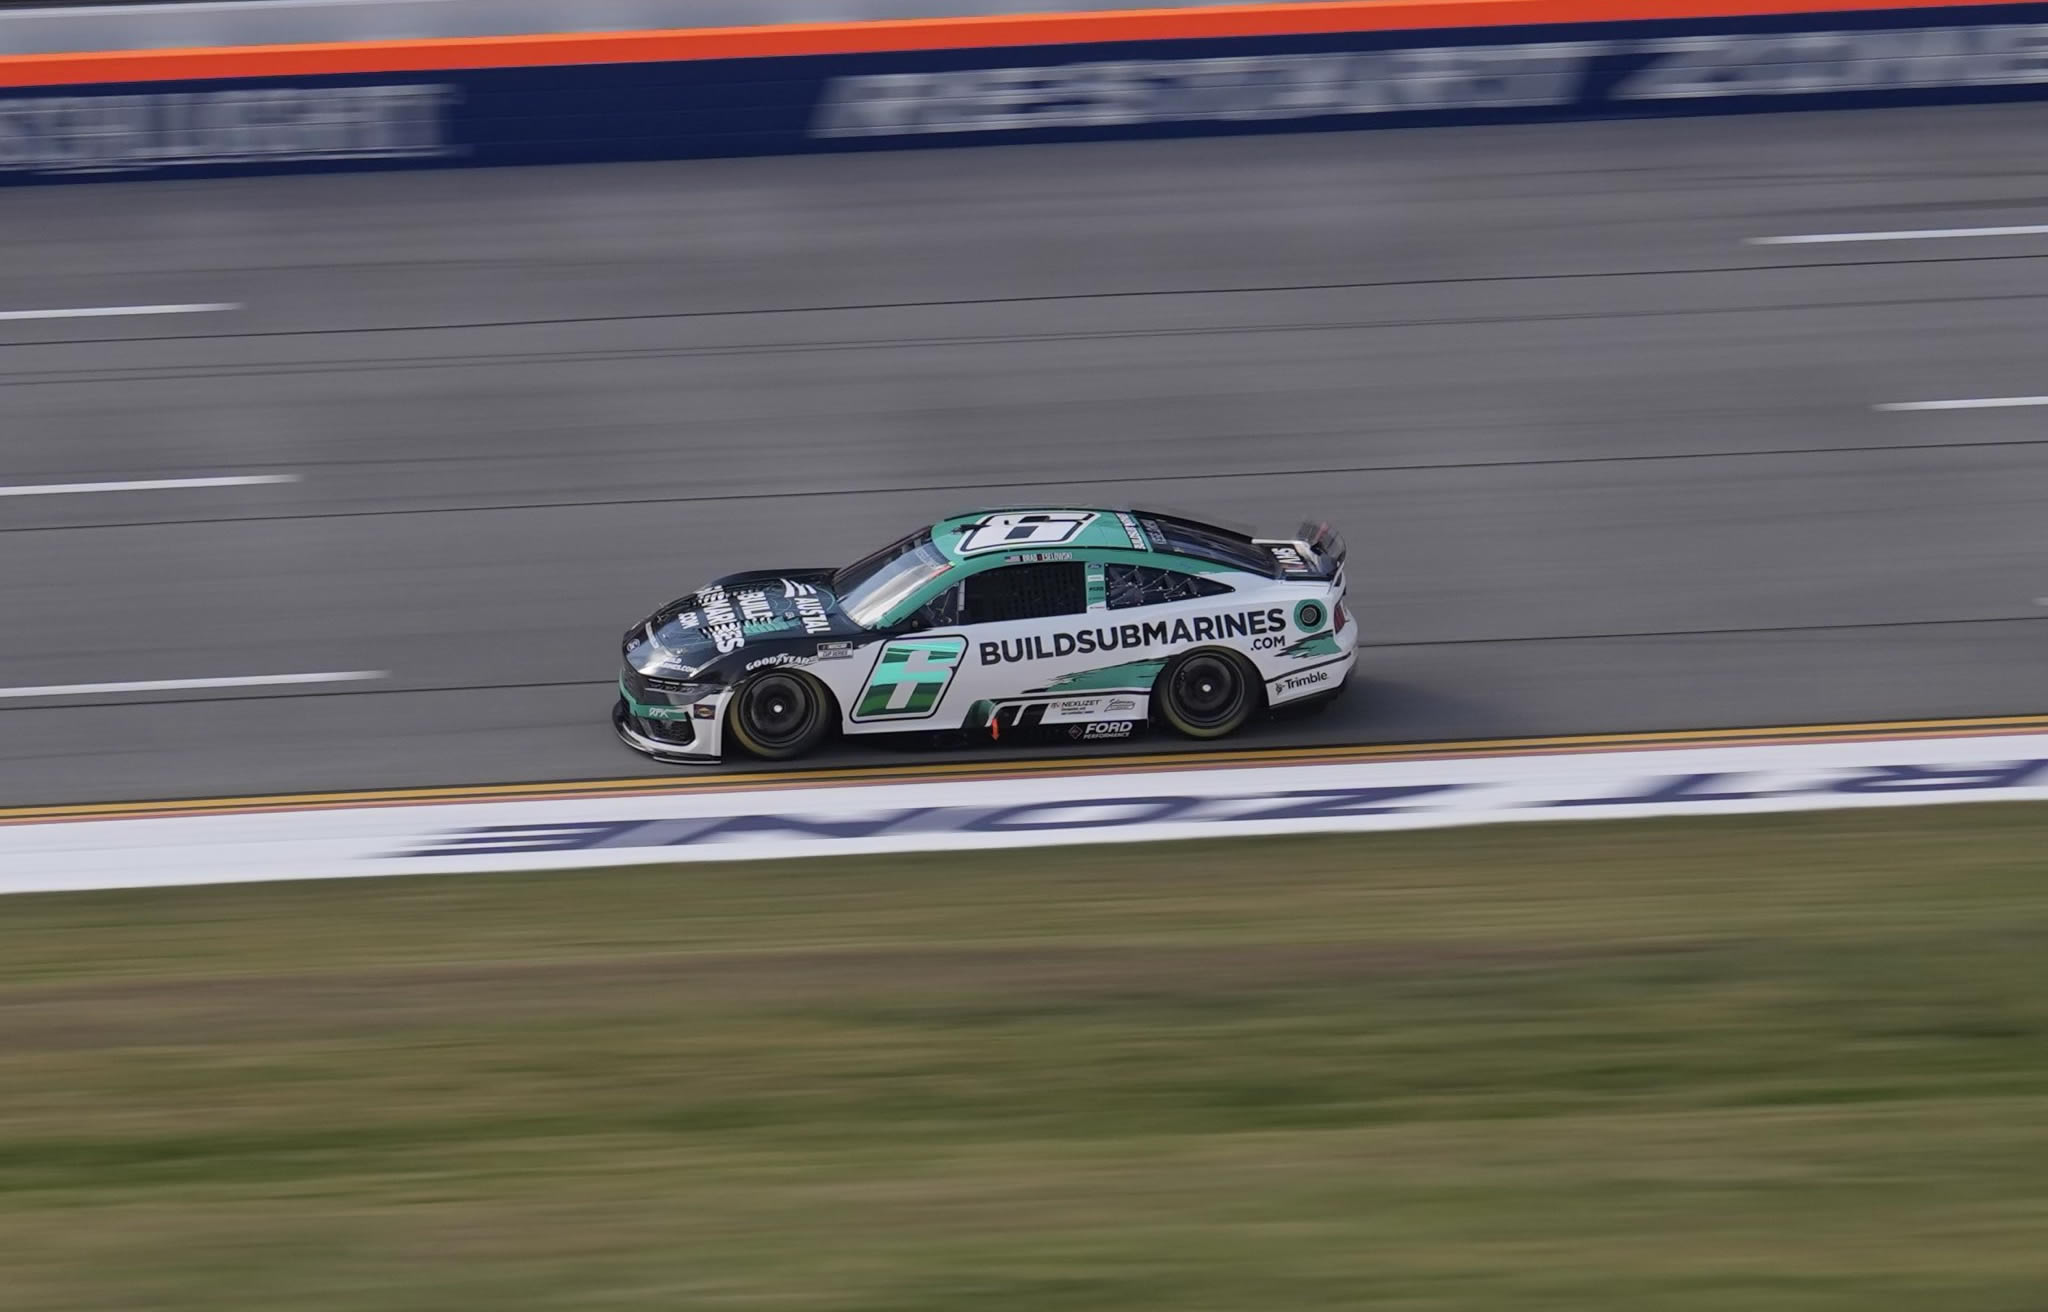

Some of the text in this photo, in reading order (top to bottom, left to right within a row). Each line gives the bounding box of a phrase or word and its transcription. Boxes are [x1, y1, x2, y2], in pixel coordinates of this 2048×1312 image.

[794, 597, 831, 634] AUSTAL
[980, 608, 1287, 666] BUILDSUBMARINES
[1250, 635, 1286, 651] .COM
[745, 652, 810, 671] GOODYEAR
[1285, 671, 1328, 690] Trimble
[1085, 721, 1133, 734] FORD
